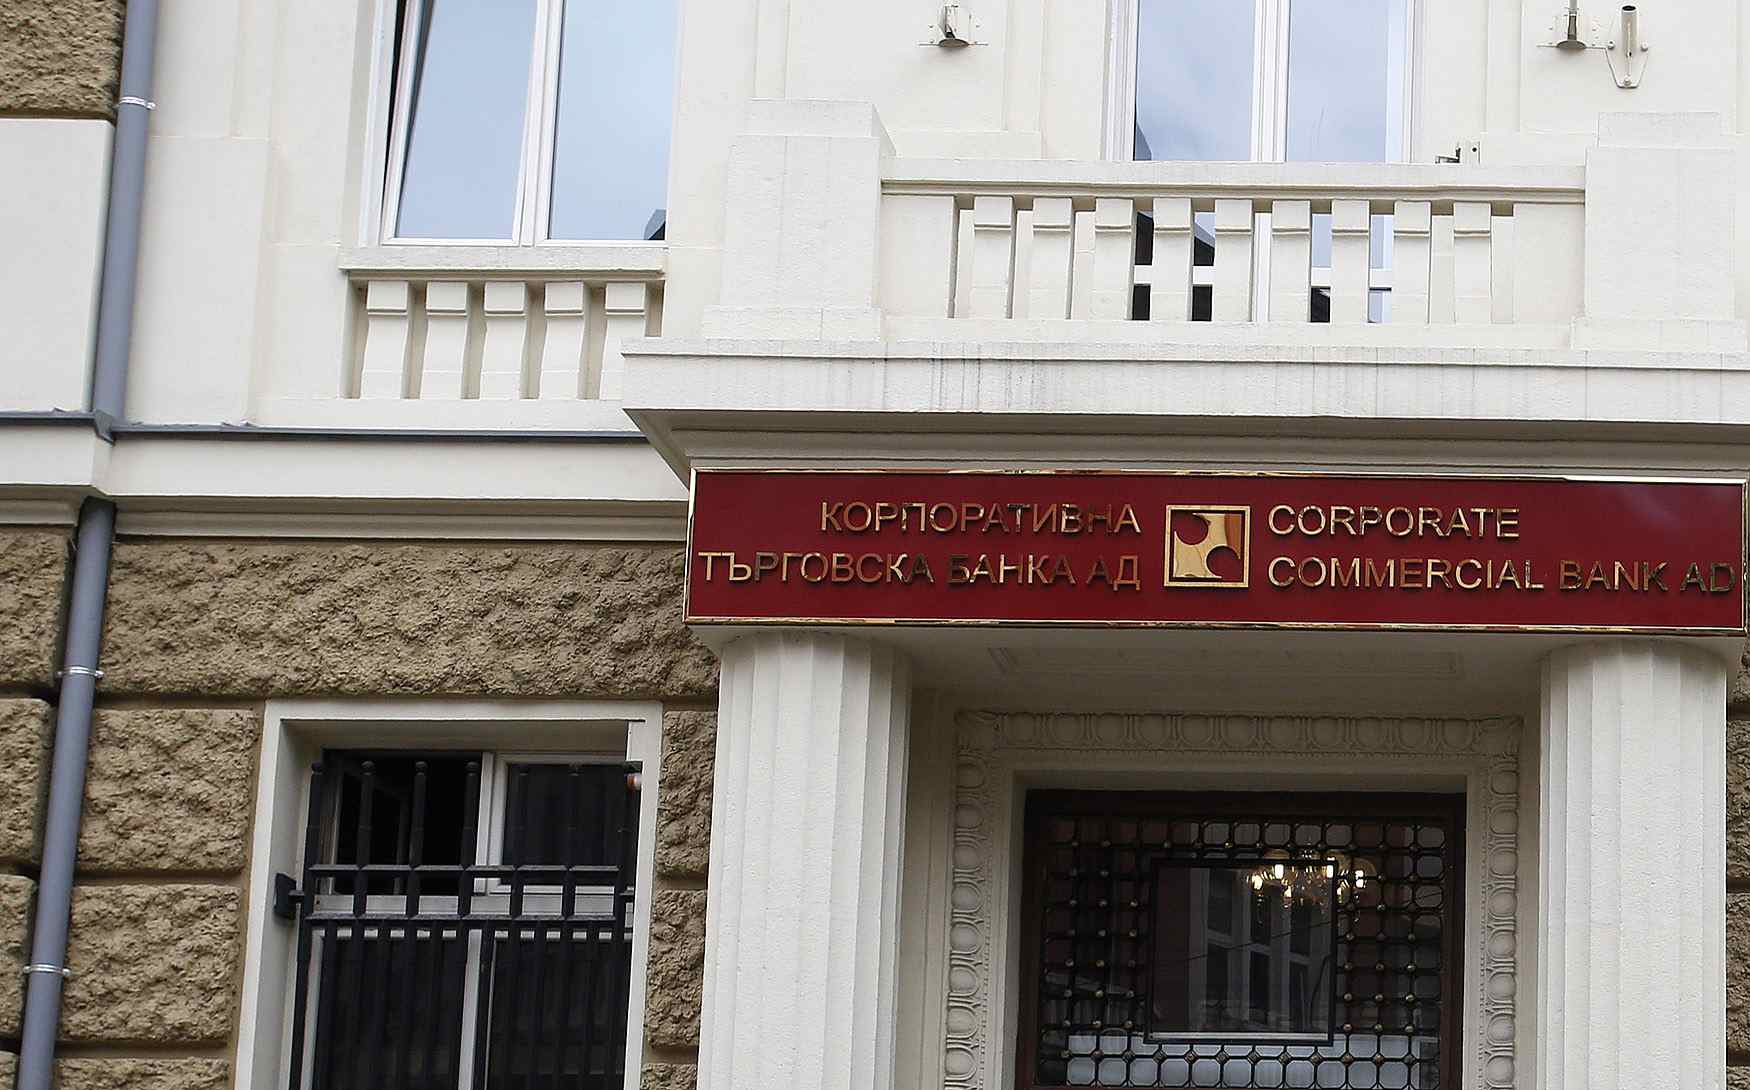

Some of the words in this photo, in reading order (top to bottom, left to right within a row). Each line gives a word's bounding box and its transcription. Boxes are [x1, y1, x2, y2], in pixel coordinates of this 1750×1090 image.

[819, 501, 1143, 534] КОРПОРАТИВНА
[1267, 504, 1521, 538] CORPORATE
[697, 551, 936, 584] ТЪРГОВСКА
[948, 553, 1077, 585] БАНКА
[1085, 554, 1142, 592] АД
[1267, 556, 1545, 589] COMMERCIAL
[1558, 559, 1669, 592] BANK
[1679, 561, 1738, 592] AD
